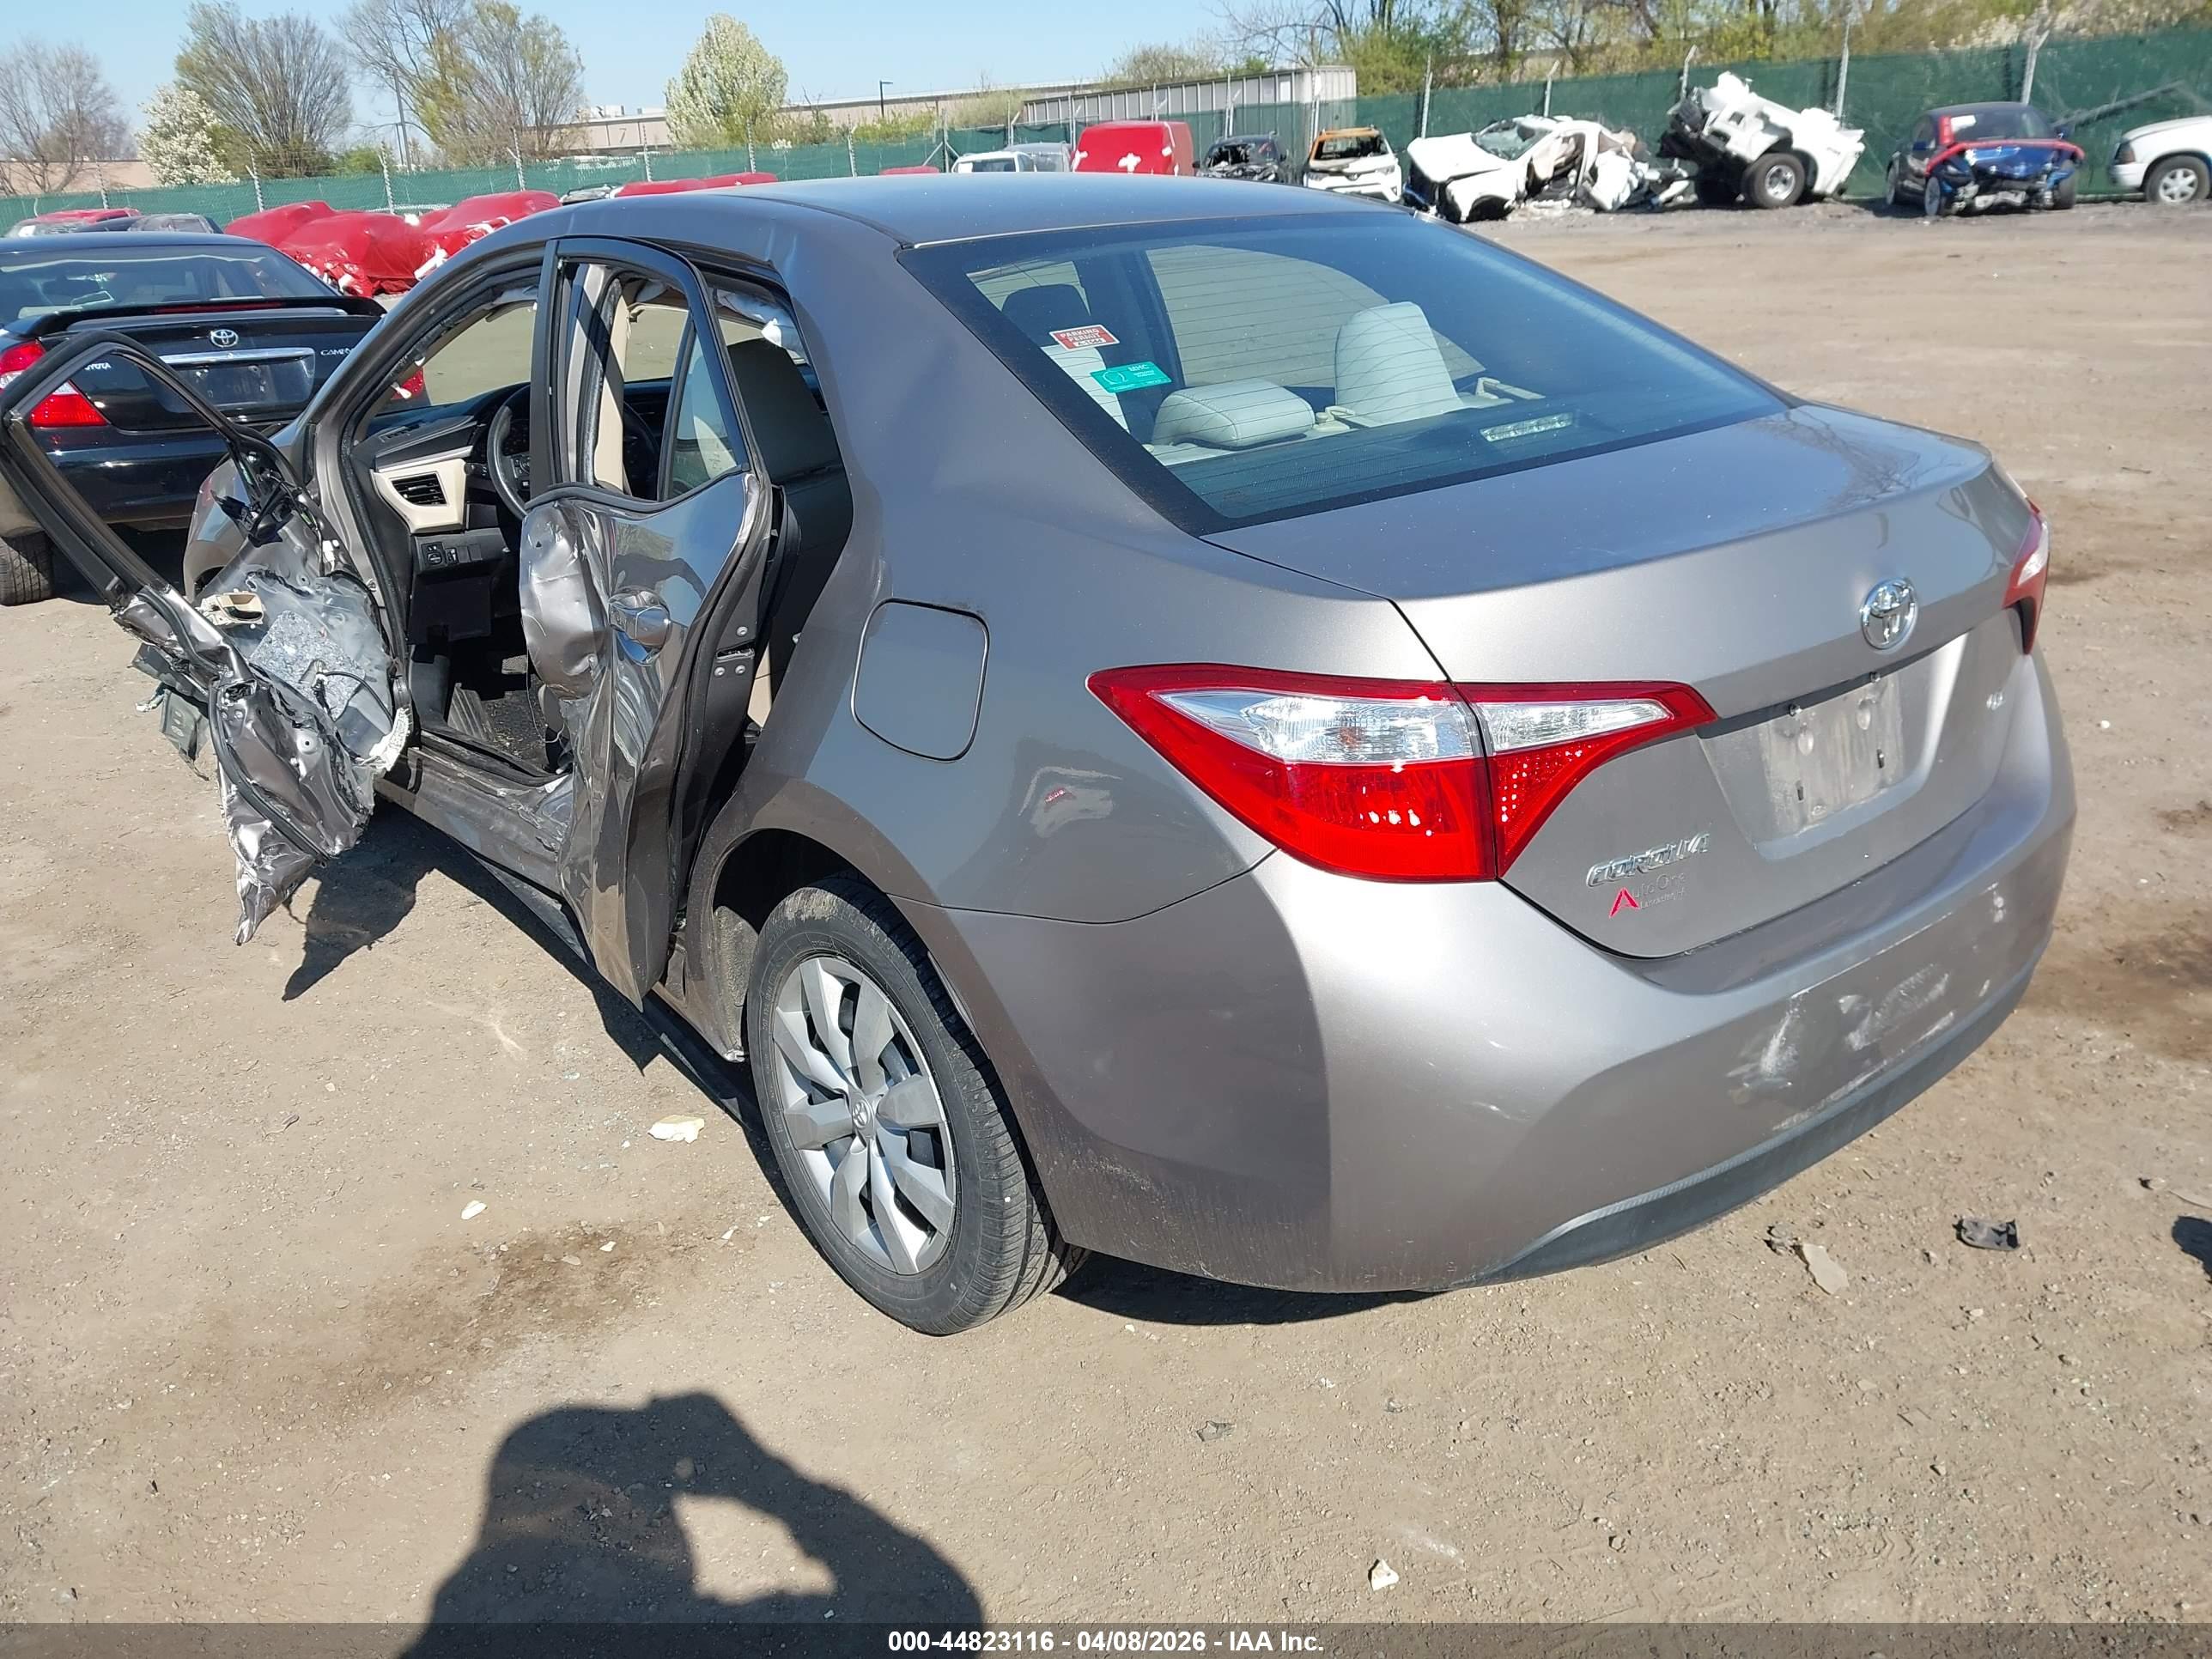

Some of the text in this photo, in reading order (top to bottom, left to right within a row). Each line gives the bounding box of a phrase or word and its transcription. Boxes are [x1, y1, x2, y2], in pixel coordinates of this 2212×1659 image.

[618, 127, 628, 144] 7
[1059, 328, 1100, 338] PARKING
[1066, 332, 1102, 343] PERMIT
[84, 362, 112, 371] YOTA
[1586, 833, 1711, 888] COROLLA
